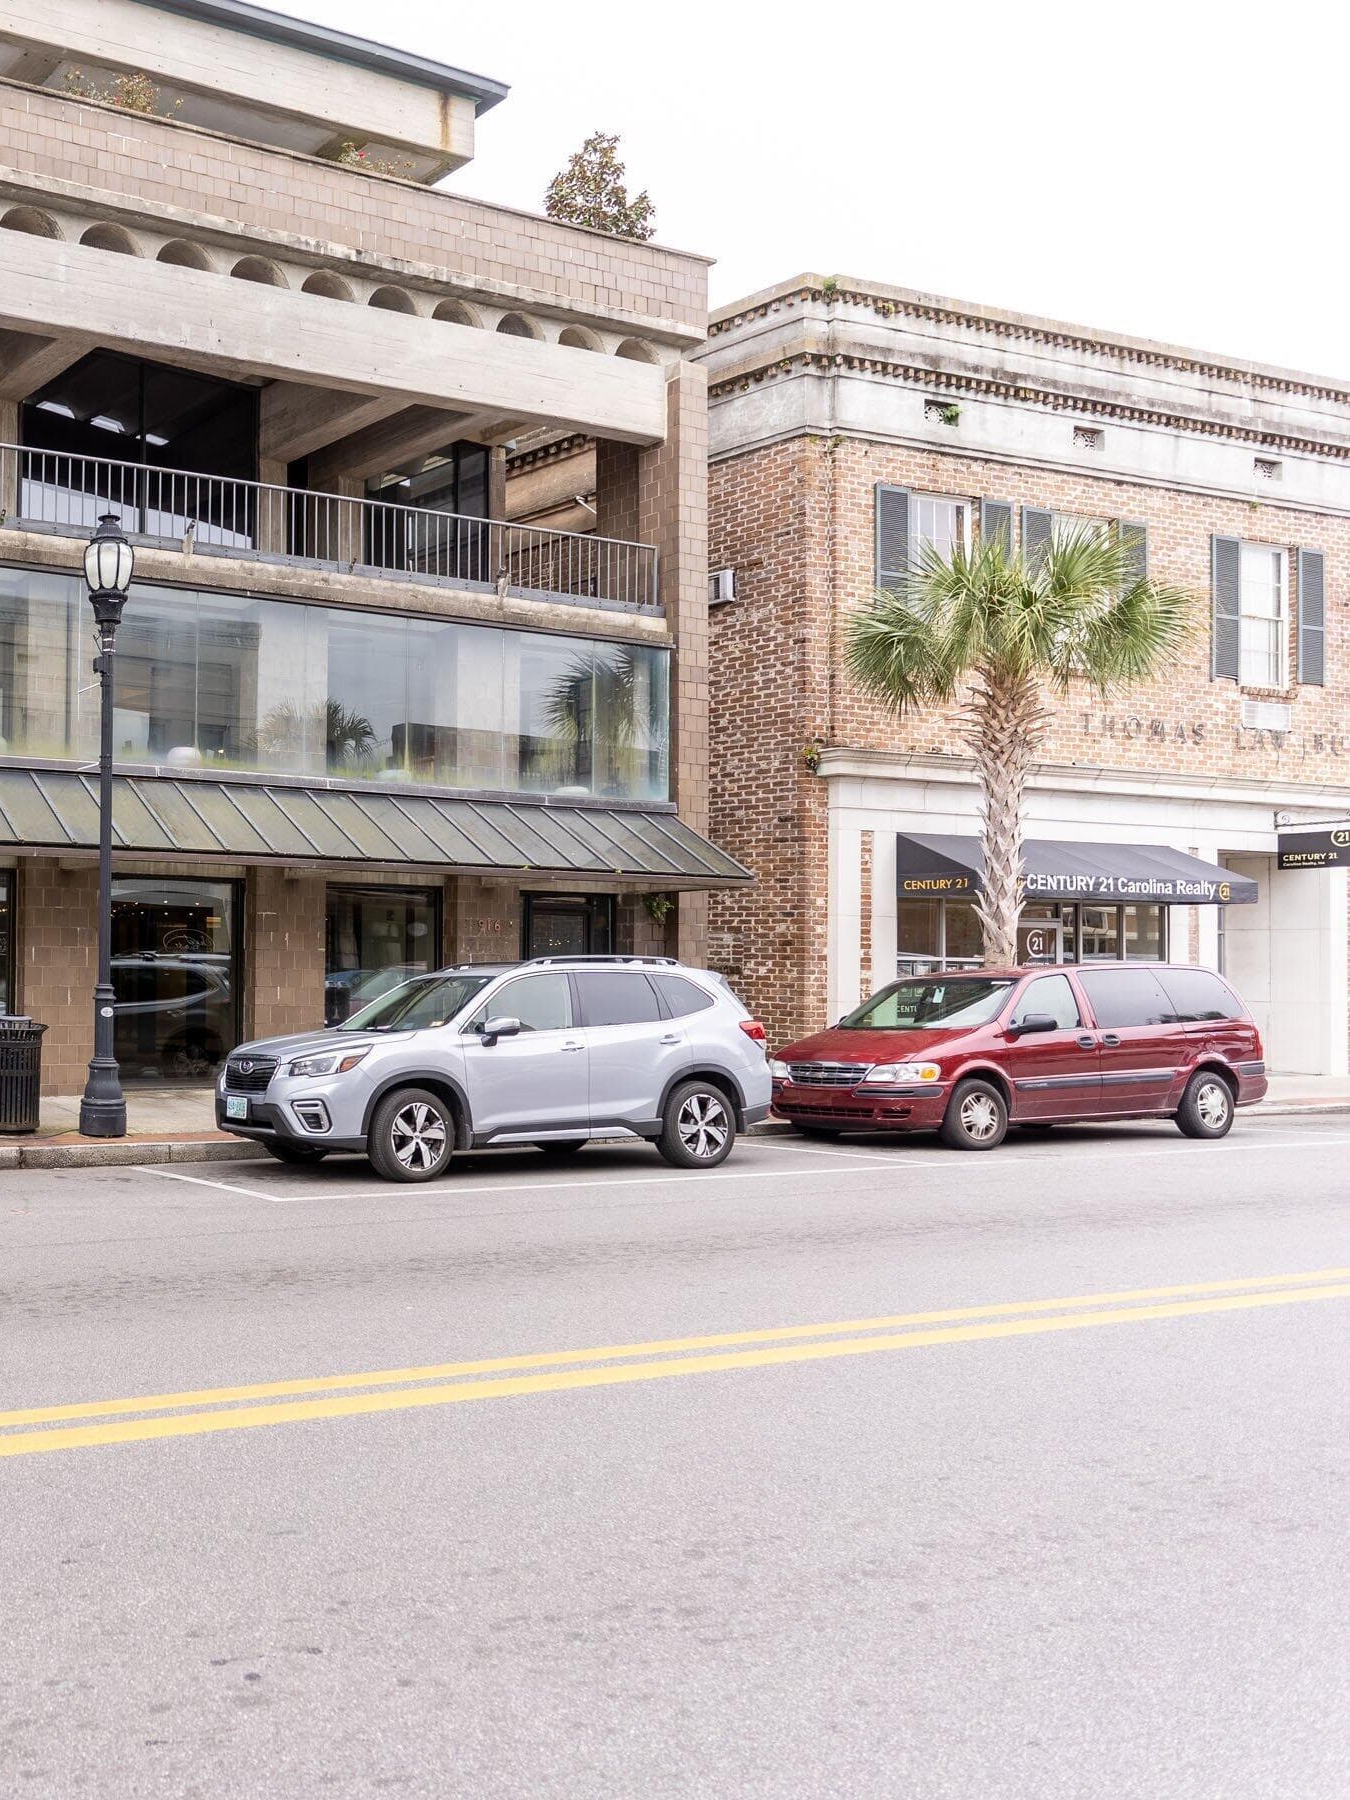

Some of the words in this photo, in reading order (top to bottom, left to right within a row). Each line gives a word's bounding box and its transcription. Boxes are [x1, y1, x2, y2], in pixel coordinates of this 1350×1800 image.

[1080, 713, 1204, 745] THOMAS
[1283, 853, 1326, 861] CENTURY
[903, 879, 953, 890] CENTURY
[955, 878, 969, 889] 21
[1027, 874, 1096, 891] CENTURY
[1099, 877, 1115, 892] 21
[1117, 877, 1173, 894] Carolina
[1176, 879, 1217, 901] Realty
